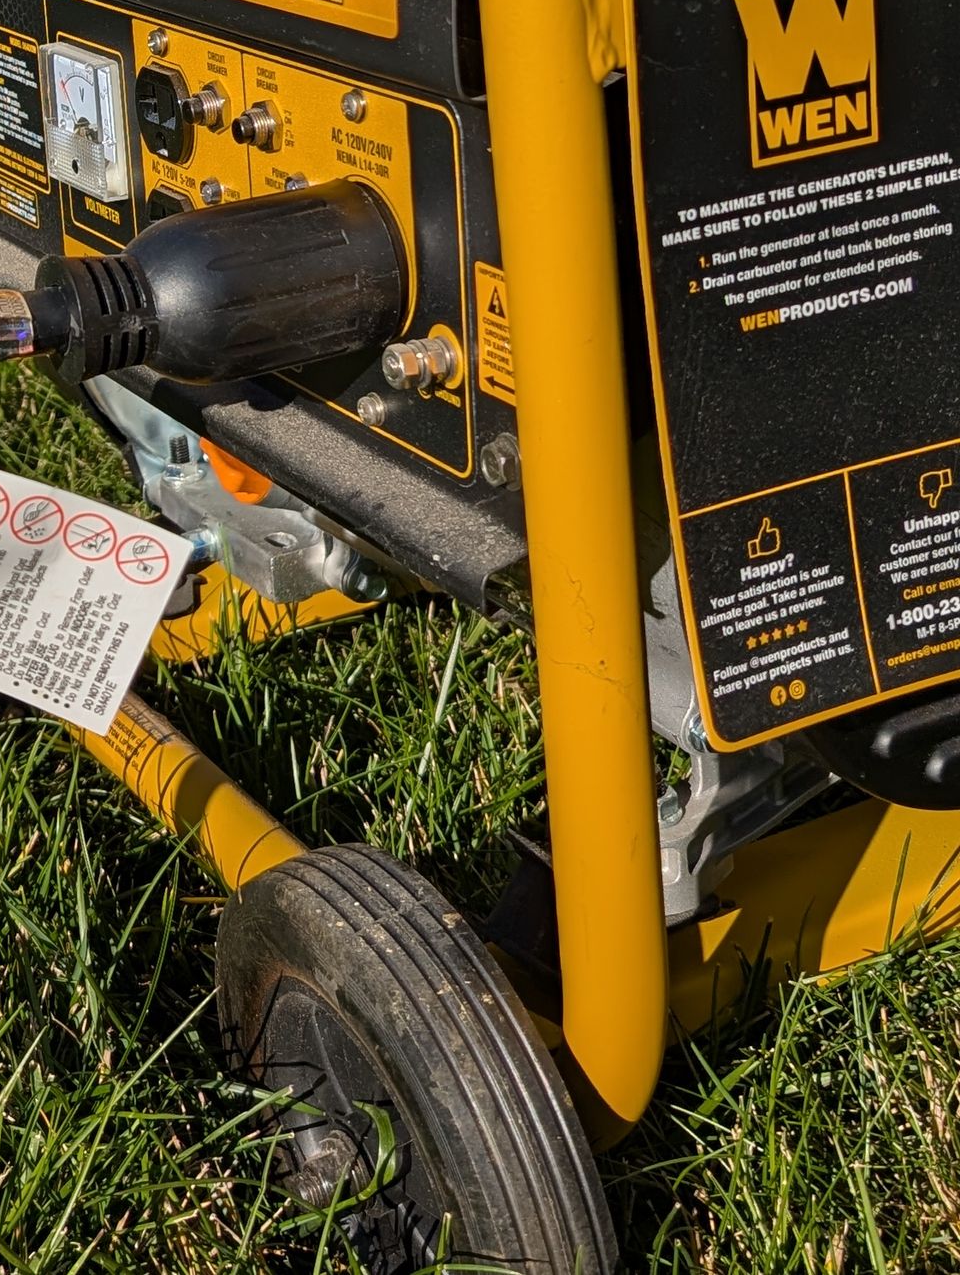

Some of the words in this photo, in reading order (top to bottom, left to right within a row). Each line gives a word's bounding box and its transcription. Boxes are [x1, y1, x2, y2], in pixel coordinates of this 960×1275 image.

[207, 50, 226, 64] CIRCUIT
[256, 66, 276, 81] CIRCUIT
[758, 90, 869, 150] WEN
[331, 127, 343, 145] AC
[344, 132, 393, 162] 120V/240V
[151, 159, 161, 175] AC
[161, 163, 178, 182] 120V
[179, 172, 196, 190] 5-20R
[336, 148, 358, 168] NEMA
[358, 156, 390, 179] L14-30R
[677, 208, 697, 223] TO
[700, 192, 766, 218] MAXIMIZE
[768, 186, 795, 202] THE
[889, 152, 953, 176] LIFESPAN,
[84, 196, 121, 225] VOLTMETER
[662, 227, 701, 247] MAKE
[703, 218, 740, 237] SURE
[742, 213, 761, 228] TO
[764, 200, 818, 223] FOLLOW
[820, 190, 863, 210] THESE
[865, 188, 874, 201] 2
[876, 177, 923, 198] SIMPLE
[699, 256, 710, 268] 1.
[712, 251, 737, 266] Run
[738, 246, 759, 259] the
[760, 232, 816, 257] generator
[818, 227, 830, 241] at
[831, 220, 860, 238] least
[861, 215, 890, 231] once
[891, 213, 899, 224] a
[901, 203, 940, 222] month.
[689, 281, 700, 293] 2.
[702, 273, 735, 290] Drain
[736, 259, 798, 282] carburetor
[800, 250, 822, 267] and
[823, 245, 846, 261] fuel
[847, 239, 873, 256] tank
[874, 232, 911, 249] before
[913, 223, 953, 240] storing
[724, 293, 745, 306] the
[746, 279, 802, 303] generator
[804, 274, 821, 287] for
[823, 259, 875, 282] extended
[877, 250, 922, 272] periods.
[740, 277, 913, 332] WENPRODUCTS.COM
[903, 509, 960, 534] Unhapp
[890, 534, 933, 555] Contact
[933, 530, 952, 545] our
[740, 553, 794, 582] Happy?
[879, 550, 930, 573] customer
[890, 569, 909, 585] We
[910, 568, 928, 580] are
[930, 556, 960, 575] ready
[69, 587, 85, 605] From
[710, 594, 736, 609] Your
[737, 575, 798, 601] satisfaction
[799, 570, 810, 581] is
[811, 565, 830, 578] our
[903, 585, 924, 601] Call
[925, 583, 937, 595] or
[89, 610, 100, 618] In
[93, 595, 107, 609] Use.
[106, 593, 122, 610] Cord.
[701, 607, 742, 629] ultimate
[744, 597, 770, 617] goal.
[771, 590, 797, 604] Take
[799, 587, 806, 597] a
[807, 575, 845, 594] minute
[57, 606, 77, 632] Remove
[83, 618, 96, 631] Not
[101, 611, 113, 622] On
[722, 625, 734, 636] to
[735, 615, 763, 632] leave
[764, 611, 779, 622] us
[780, 608, 787, 618] a
[788, 596, 826, 615] review.
[54, 633, 65, 641] to
[75, 631, 90, 649] When
[91, 623, 111, 645] Pulling
[115, 622, 129, 637] TAG
[916, 625, 937, 640] M-F
[43, 643, 60, 664] PLUG
[44, 670, 61, 693] Always
[54, 652, 69, 669] Store
[62, 633, 78, 650] Cord
[70, 600, 92, 633] INDOORS.
[87, 644, 100, 655] By
[107, 637, 122, 654] THIS
[713, 662, 748, 682] Follow
[749, 637, 828, 669] @wenproducts
[828, 627, 849, 644] and
[24, 659, 41, 684] AFTER
[35, 643, 48, 659] USE
[64, 651, 84, 673] Unplug
[76, 655, 96, 678] Unplug
[94, 653, 115, 684] REMOVE
[713, 678, 745, 698] share
[743, 671, 768, 690] your
[769, 656, 812, 681] projects
[813, 648, 836, 663] with
[837, 644, 854, 656] us.
[33, 663, 50, 688] GRASP
[54, 674, 72, 697] Always
[70, 678, 83, 691] Not
[65, 692, 77, 703] Do
[87, 683, 101, 699] NOT
[94, 680, 117, 716] SM401E
[82, 698, 94, 711] DO
